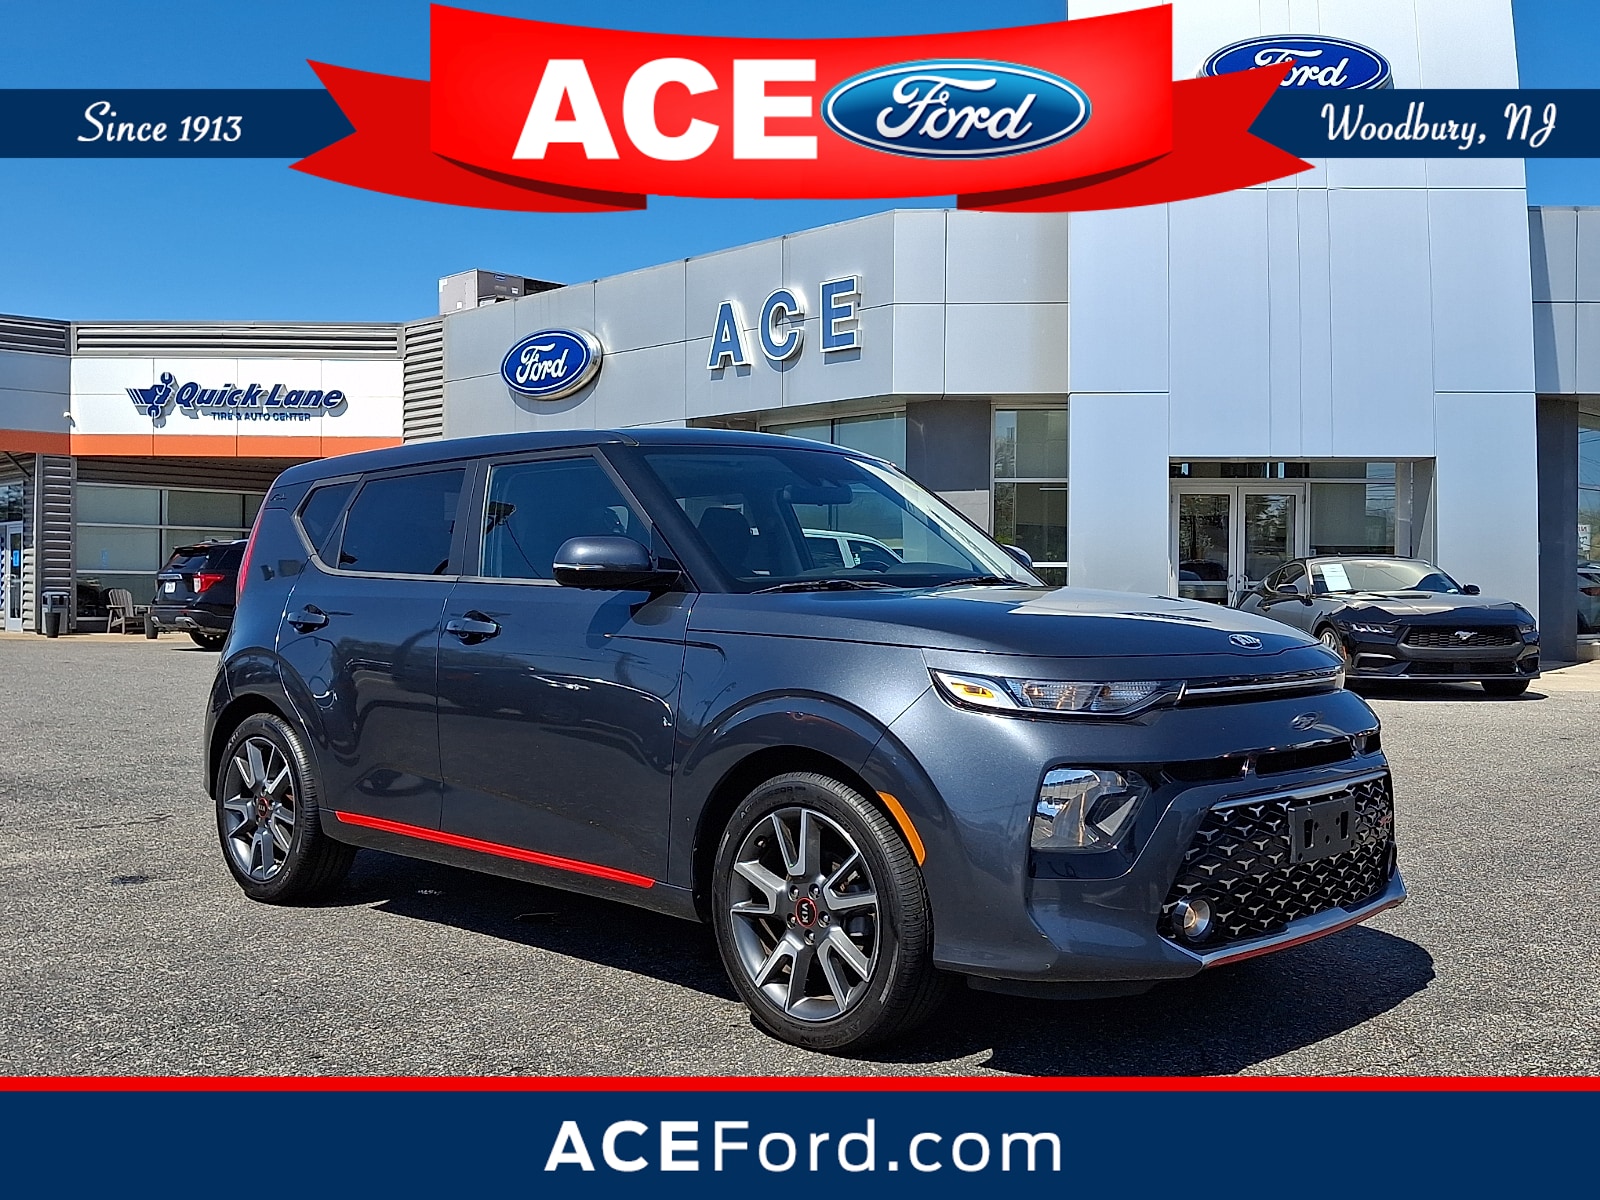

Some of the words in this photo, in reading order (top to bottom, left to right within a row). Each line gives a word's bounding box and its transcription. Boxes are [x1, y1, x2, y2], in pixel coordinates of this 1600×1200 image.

[707, 274, 863, 371] ACE
[515, 342, 569, 384] Ford
[175, 381, 261, 408] Quick
[264, 383, 345, 408] Lane
[211, 411, 234, 421] TIRE
[235, 412, 242, 421] &
[243, 412, 271, 422] AUTO
[272, 412, 311, 422] CENTER
